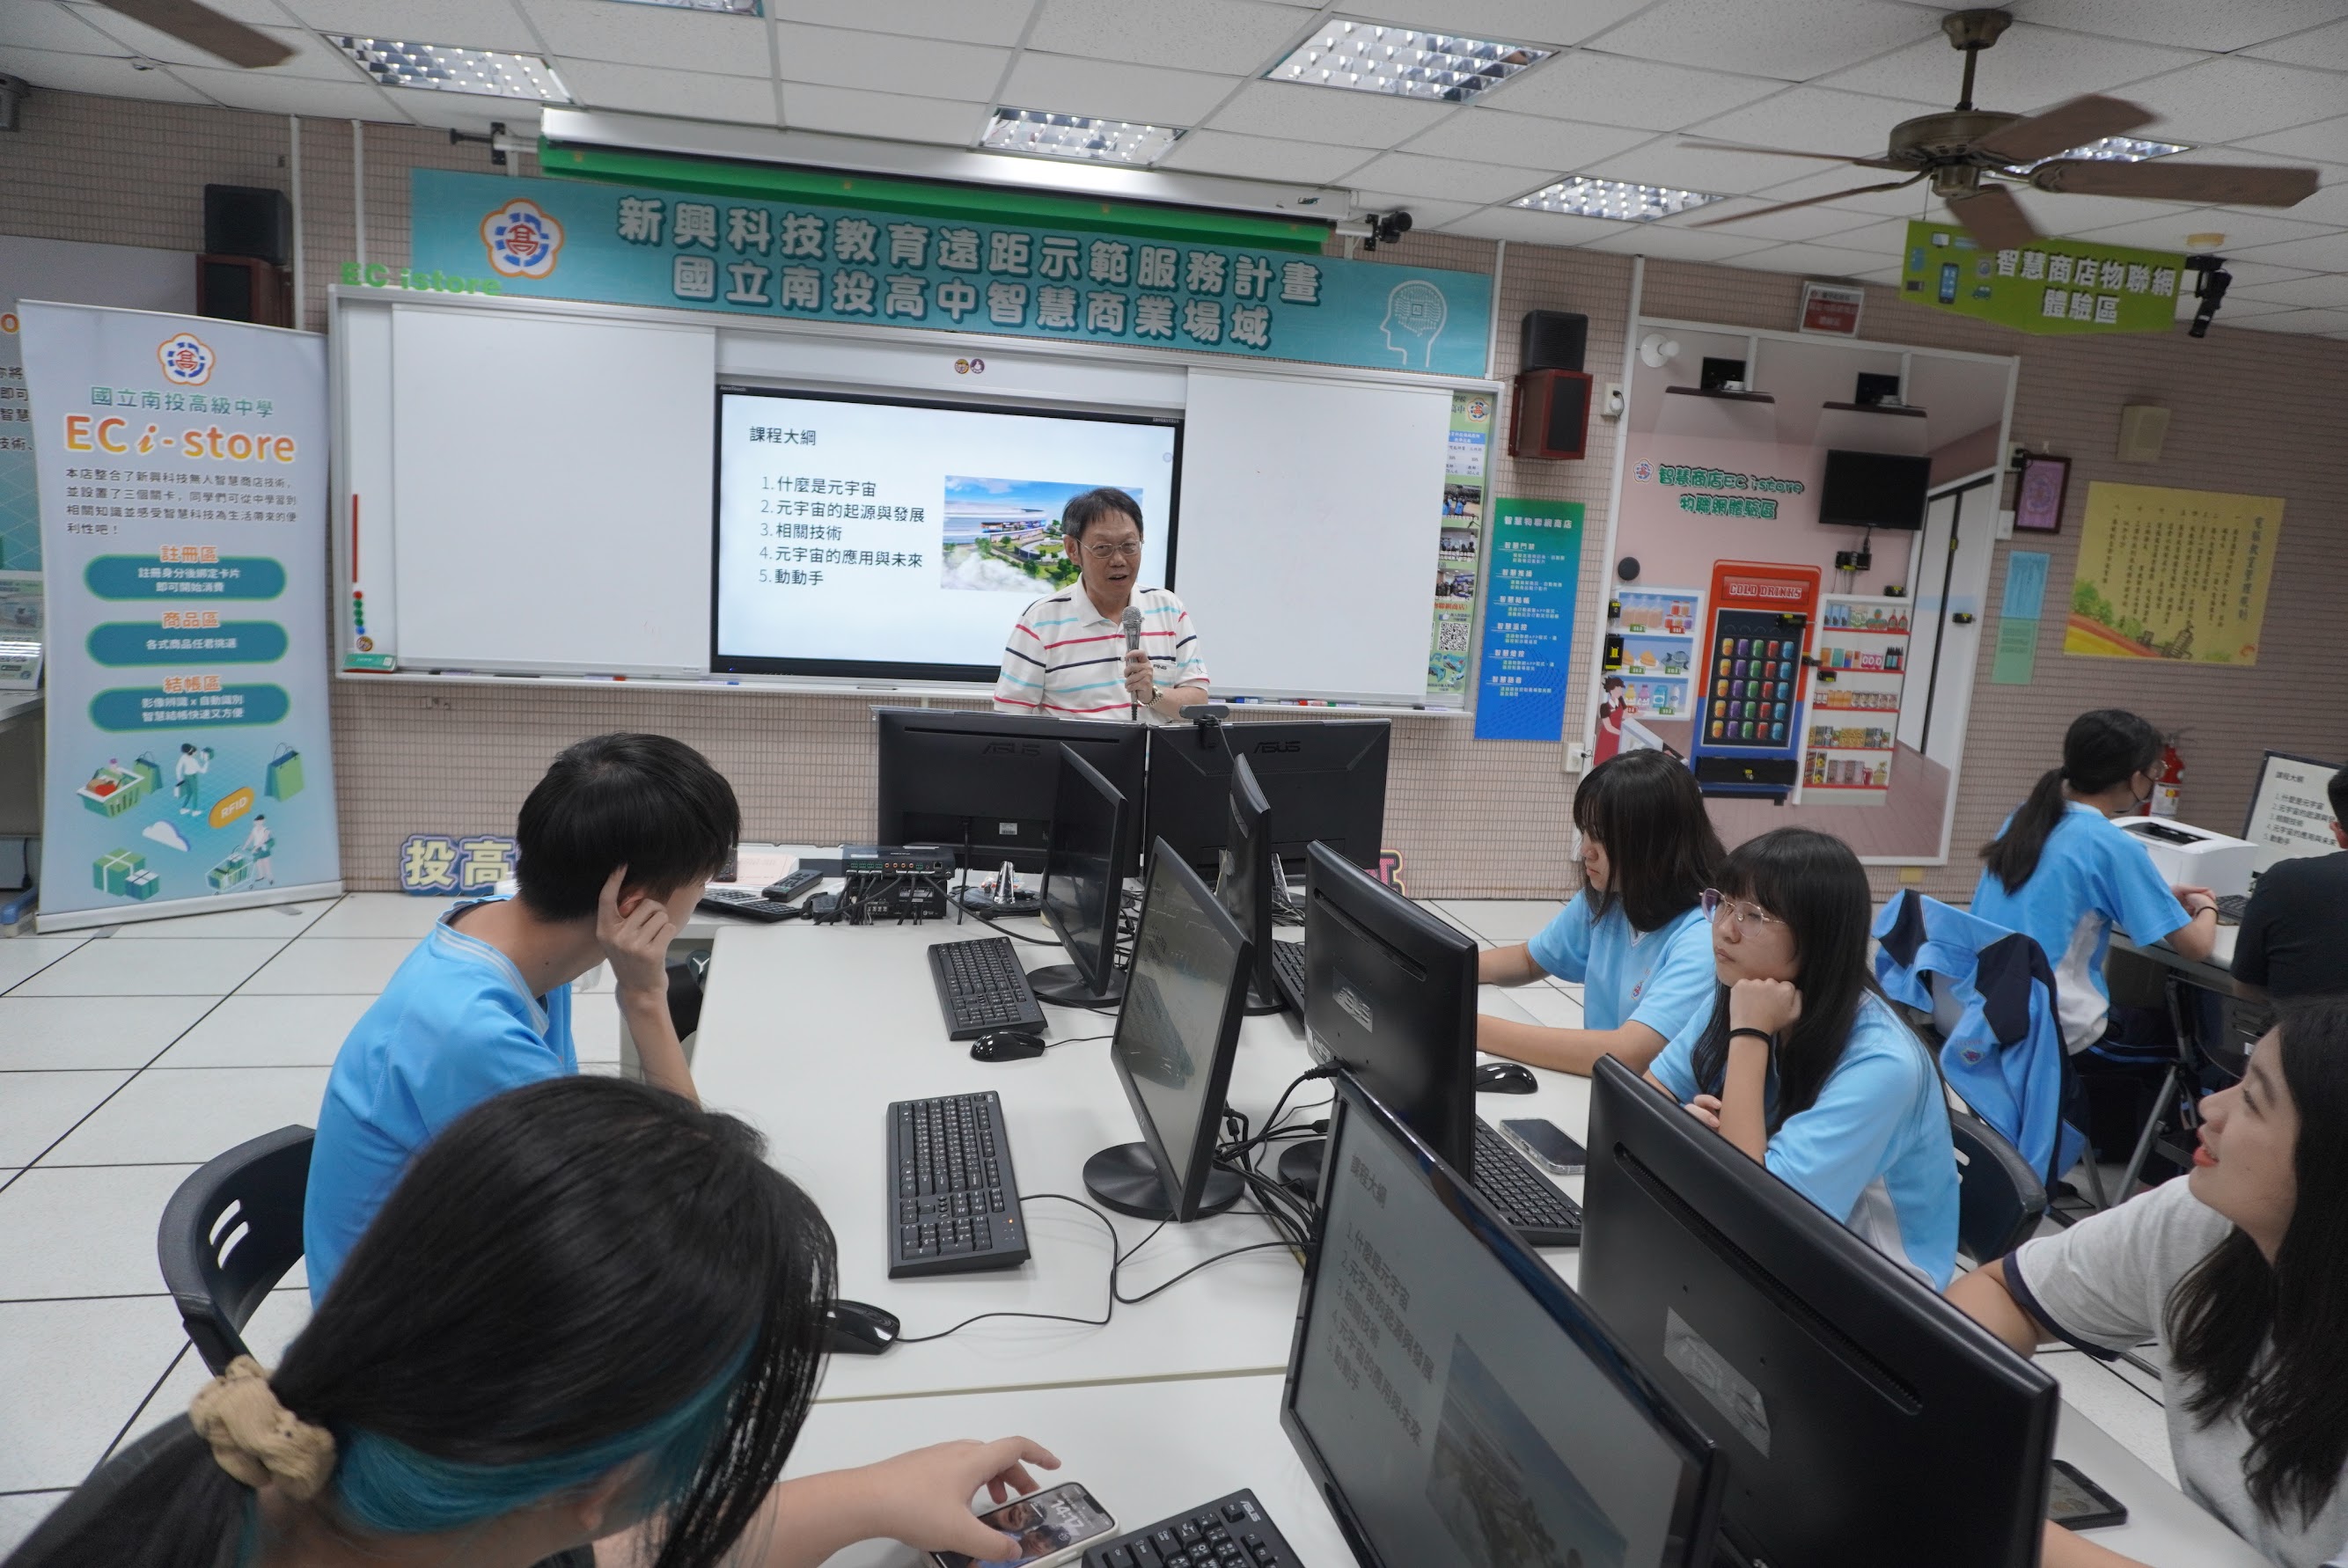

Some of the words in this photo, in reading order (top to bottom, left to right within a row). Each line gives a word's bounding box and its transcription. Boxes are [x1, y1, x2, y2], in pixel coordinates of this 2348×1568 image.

[618, 195, 1322, 305] 新興科技教育遠距示範服務計畫
[341, 261, 389, 288] EC
[400, 267, 502, 296] istore
[1996, 249, 2176, 297] 智慧商店物聯網
[672, 254, 1273, 349] 國立南投高中智慧商業場域
[2042, 287, 2120, 324] 體驗區
[91, 386, 274, 418] 國立南投高級中學
[66, 415, 127, 453] EC
[749, 426, 816, 446] 課程大綱
[160, 546, 219, 563] 註冊區
[1729, 583, 1758, 596] COLD
[1759, 584, 1802, 599] DRINKS
[162, 612, 220, 628] 商品區
[163, 676, 222, 693] 結帳區
[1253, 741, 1301, 754] ASUS
[221, 795, 248, 819] RFID
[1240, 1500, 1261, 1522] ASUS
